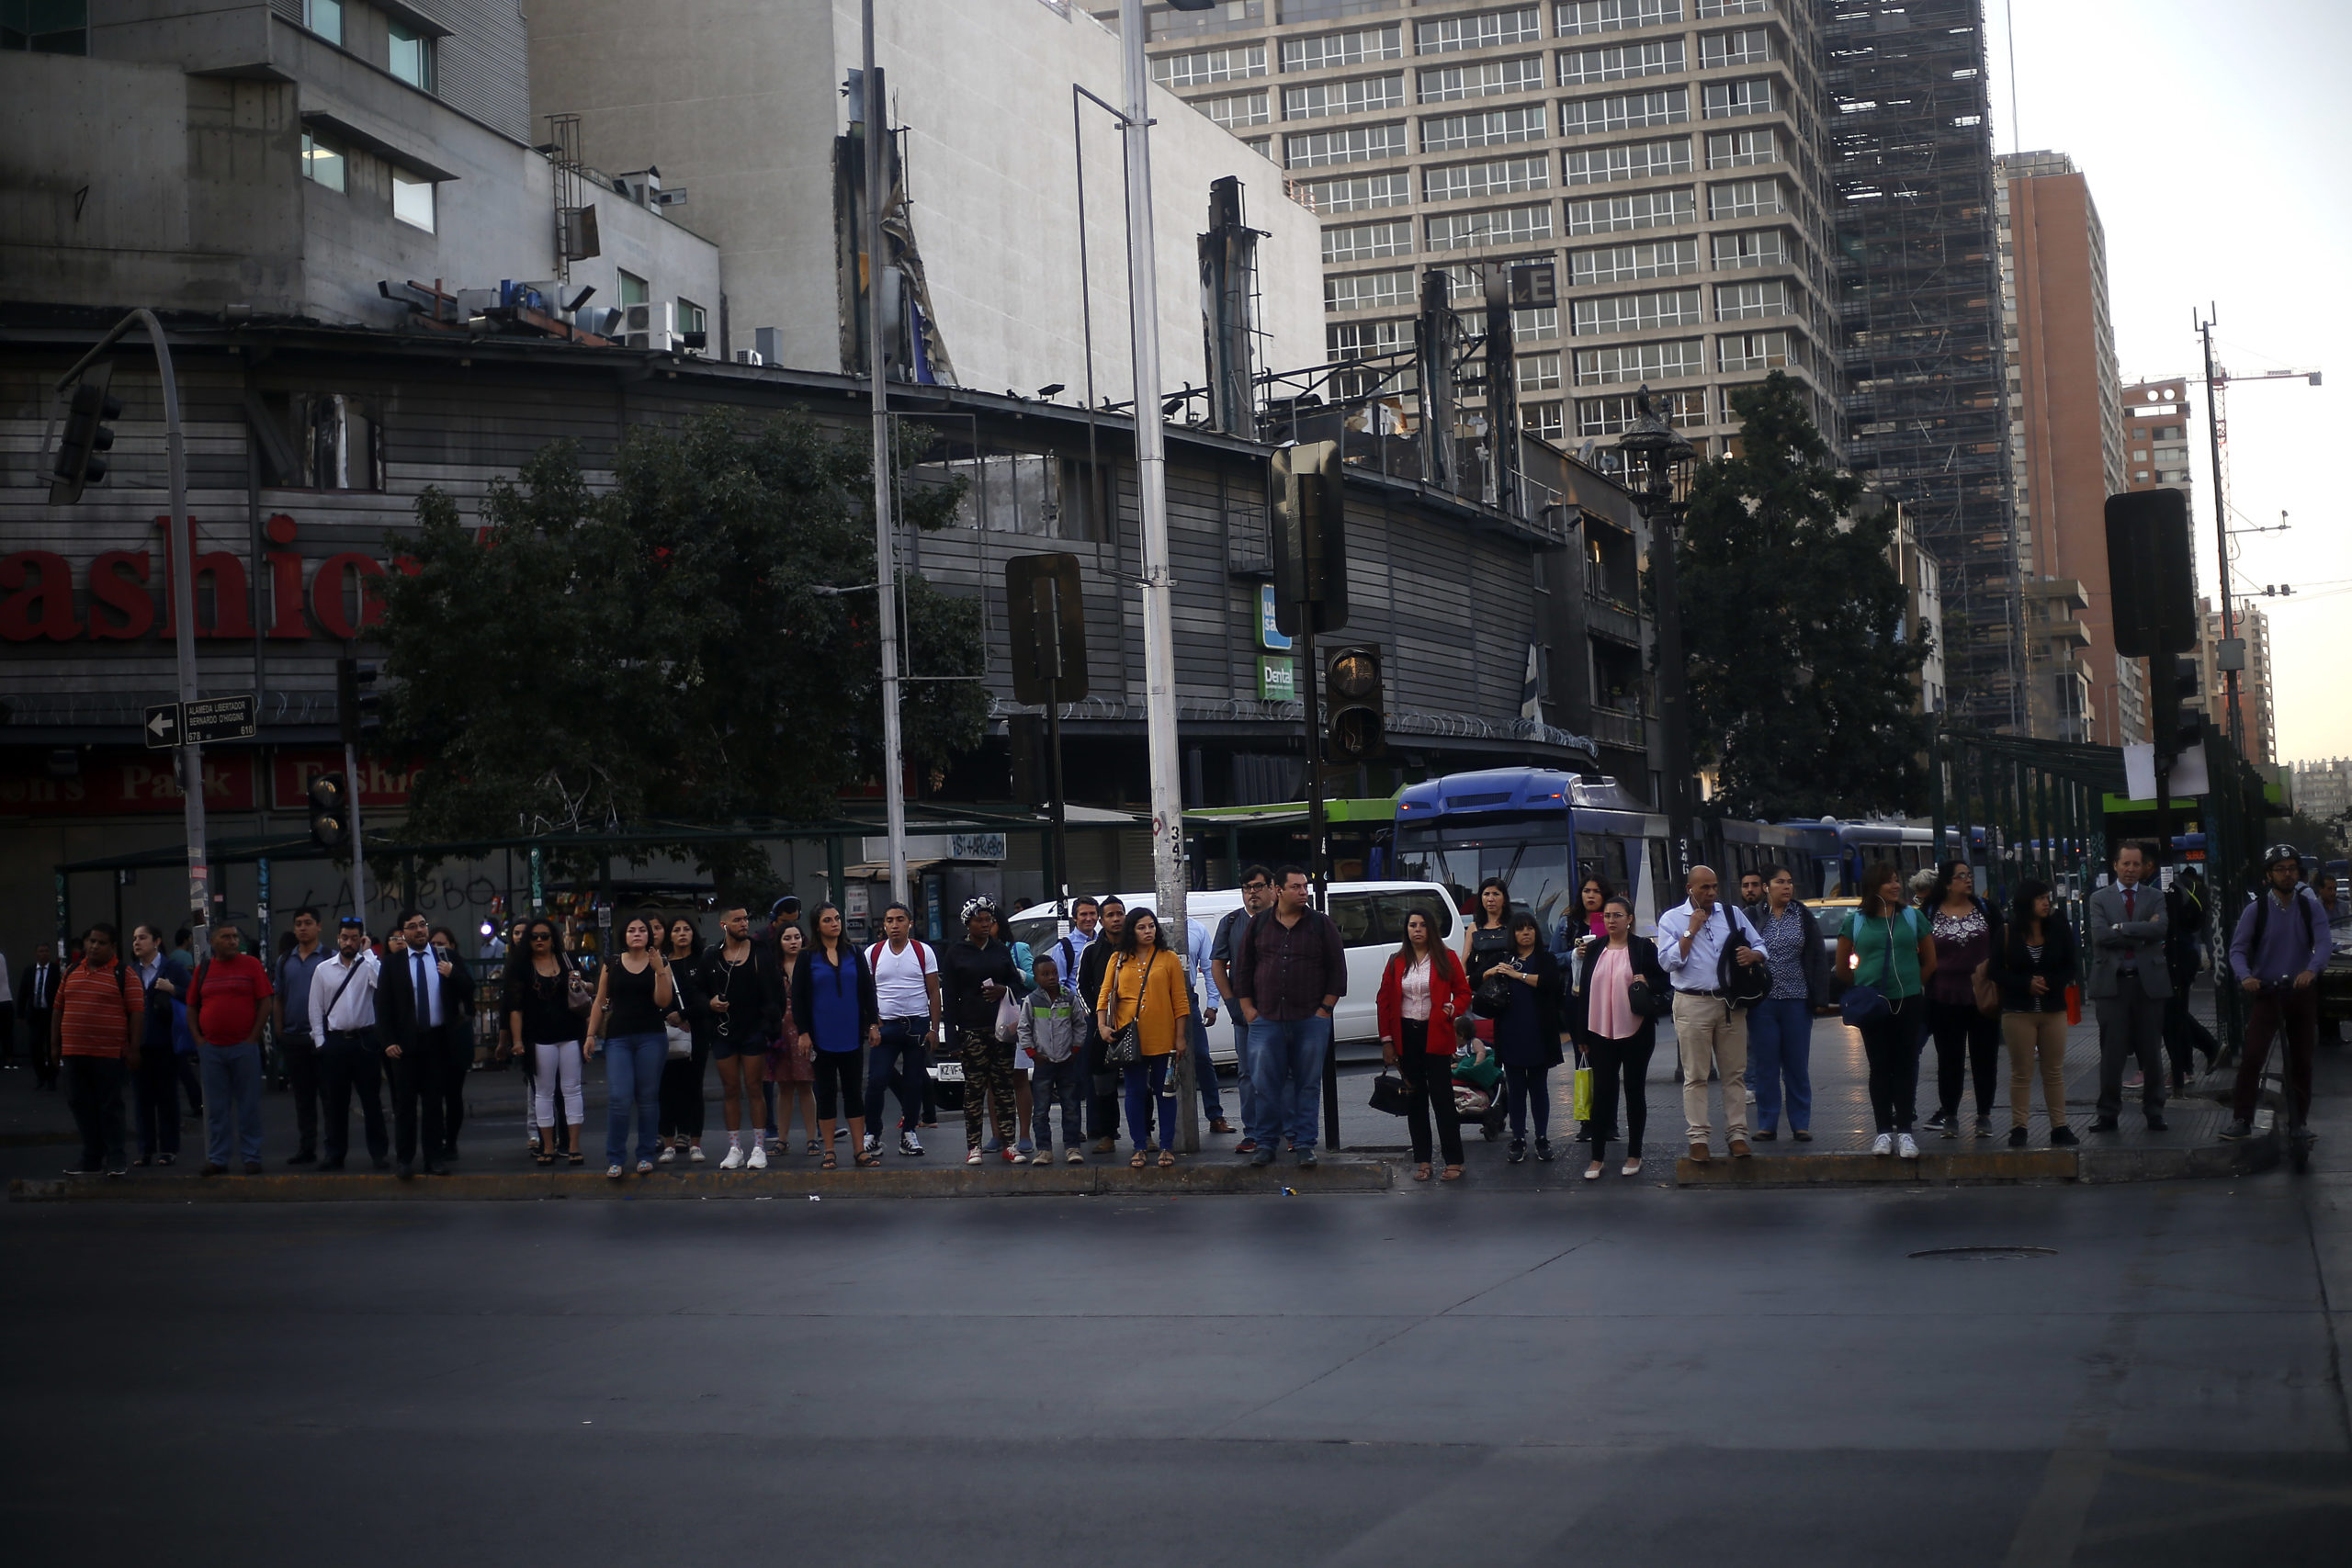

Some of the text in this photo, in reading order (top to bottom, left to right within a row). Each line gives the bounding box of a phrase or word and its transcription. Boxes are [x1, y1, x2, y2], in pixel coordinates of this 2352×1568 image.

[1530, 270, 1554, 301] E
[0, 515, 423, 642] ashio
[1264, 666, 1293, 684] Dental
[188, 701, 246, 715] ALAMEDA LIBERTADOR
[189, 712, 244, 727] BERNARDO O'HIGGINS
[187, 731, 201, 742] 678
[241, 725, 254, 736] 610
[118, 764, 233, 800] Pak
[291, 761, 426, 795] Fshi
